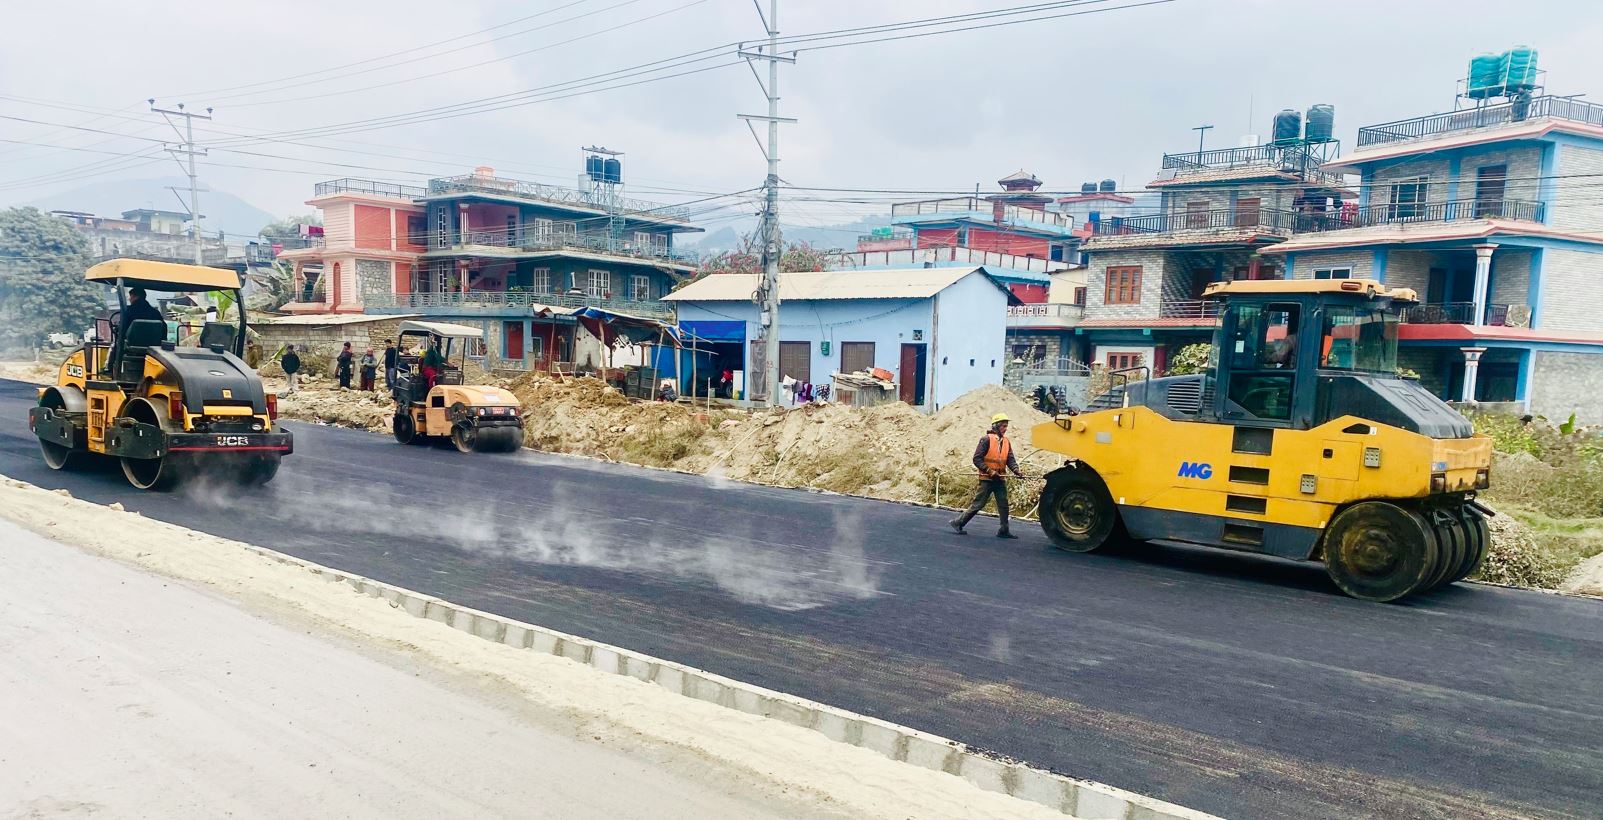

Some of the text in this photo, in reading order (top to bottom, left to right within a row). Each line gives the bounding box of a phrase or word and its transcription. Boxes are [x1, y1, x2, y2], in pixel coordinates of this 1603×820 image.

[67, 364, 83, 378] JCB
[217, 436, 249, 446] JCB
[1177, 461, 1213, 480] MG
